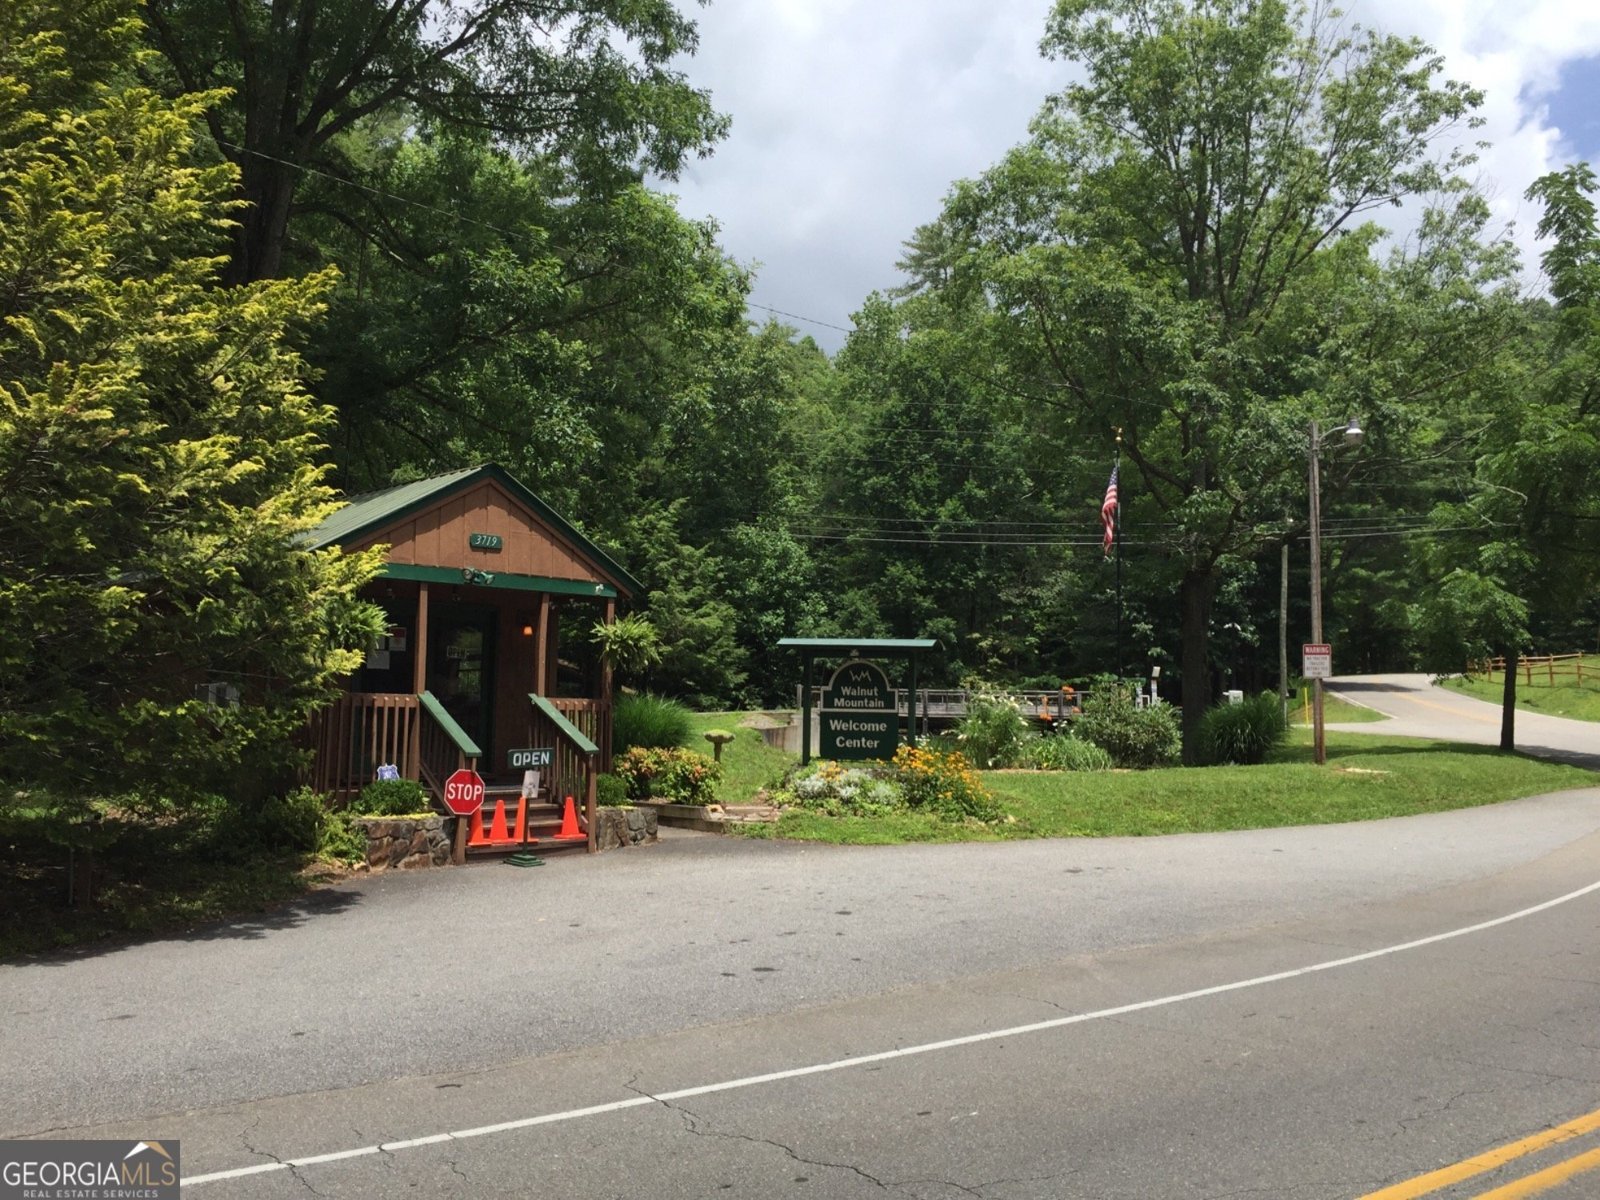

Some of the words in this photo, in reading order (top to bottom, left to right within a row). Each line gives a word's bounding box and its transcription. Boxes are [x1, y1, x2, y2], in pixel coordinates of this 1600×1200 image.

[475, 535, 497, 546] 3719
[1305, 646, 1329, 654] WARNING
[841, 686, 879, 696] Walnut
[834, 698, 884, 708] Mountain
[829, 719, 887, 732] Welcome
[836, 736, 880, 748] Center
[513, 751, 550, 767] OPEN
[447, 783, 482, 801] STOP
